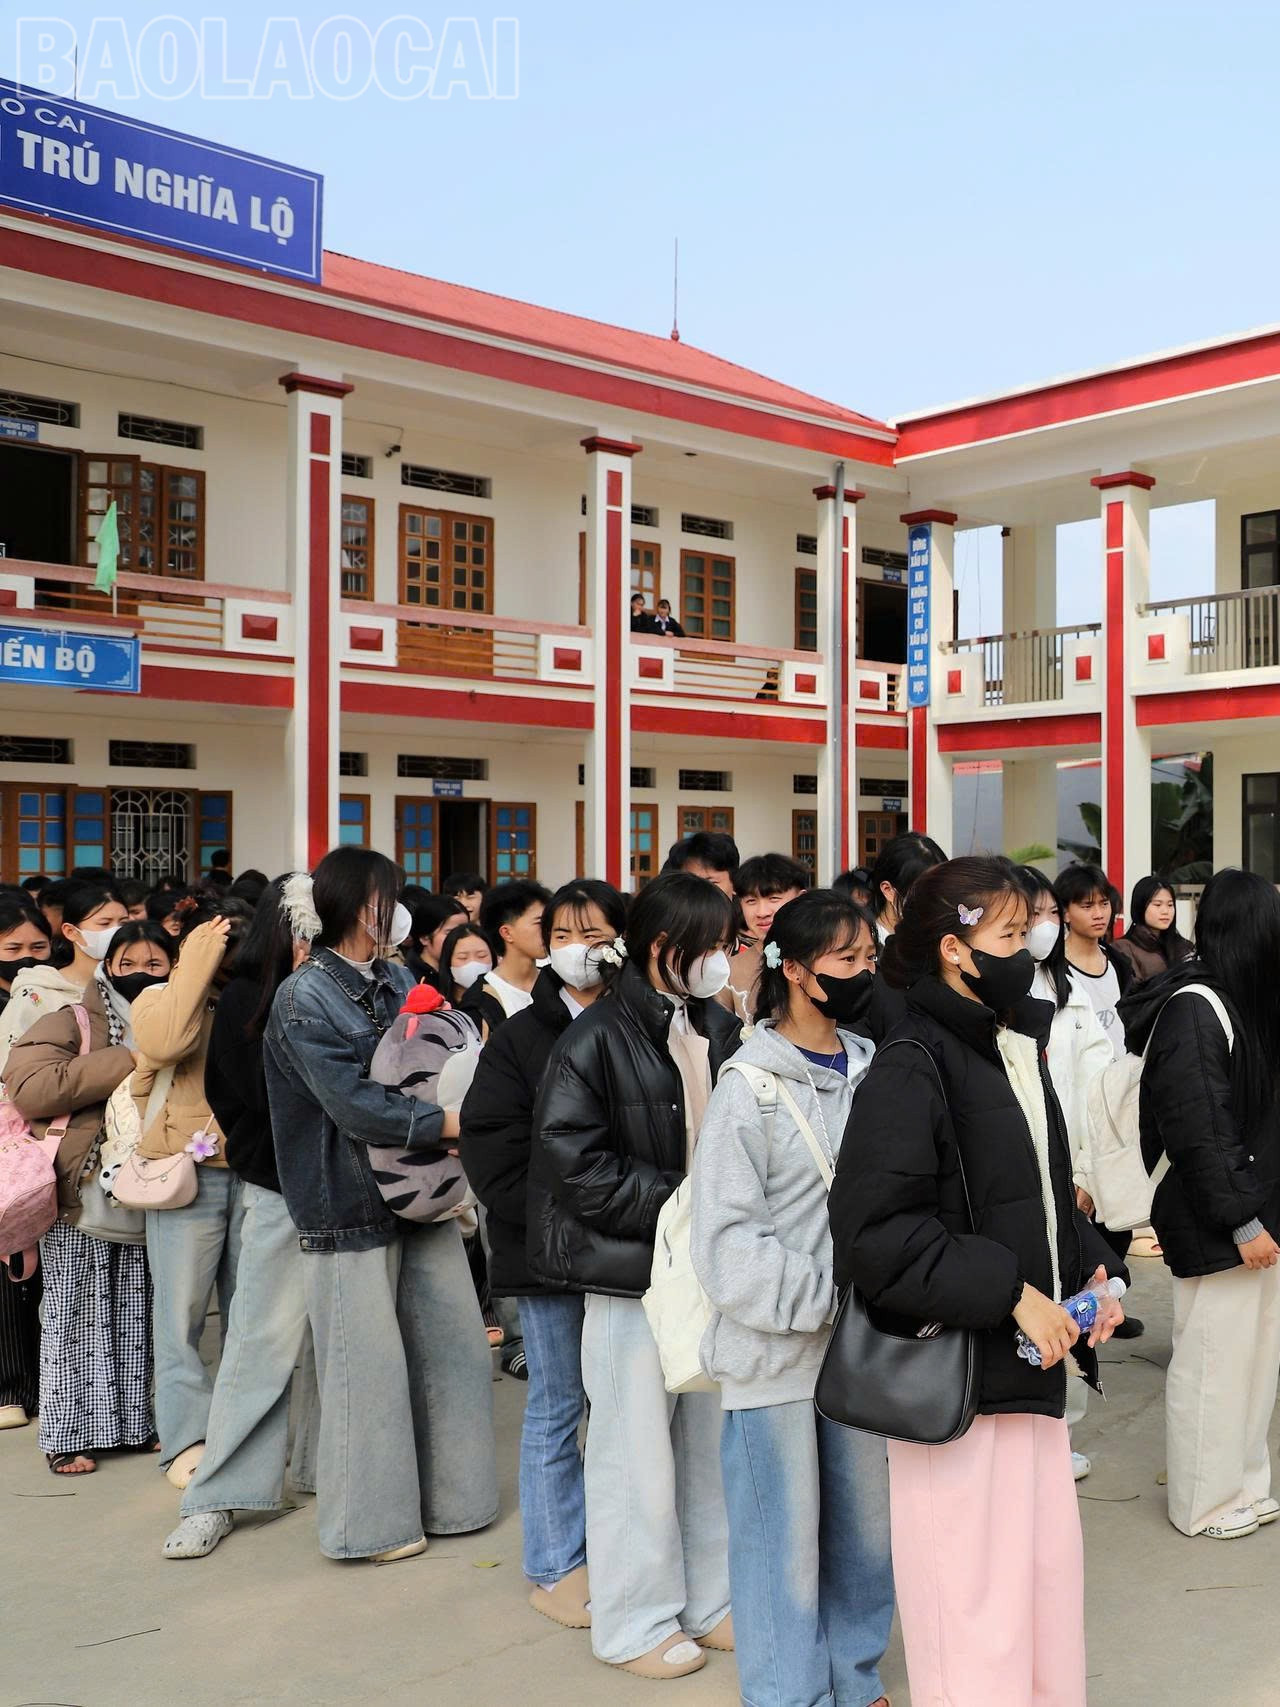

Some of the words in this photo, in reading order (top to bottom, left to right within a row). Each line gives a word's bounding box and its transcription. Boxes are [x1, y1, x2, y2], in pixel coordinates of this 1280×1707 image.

[34, 108, 86, 135] CAI
[16, 129, 100, 186] TRÚ
[114, 157, 239, 224] NGHĨA
[250, 195, 295, 245] LỘ
[0, 636, 46, 669] ẾN
[55, 645, 96, 678] BỘ
